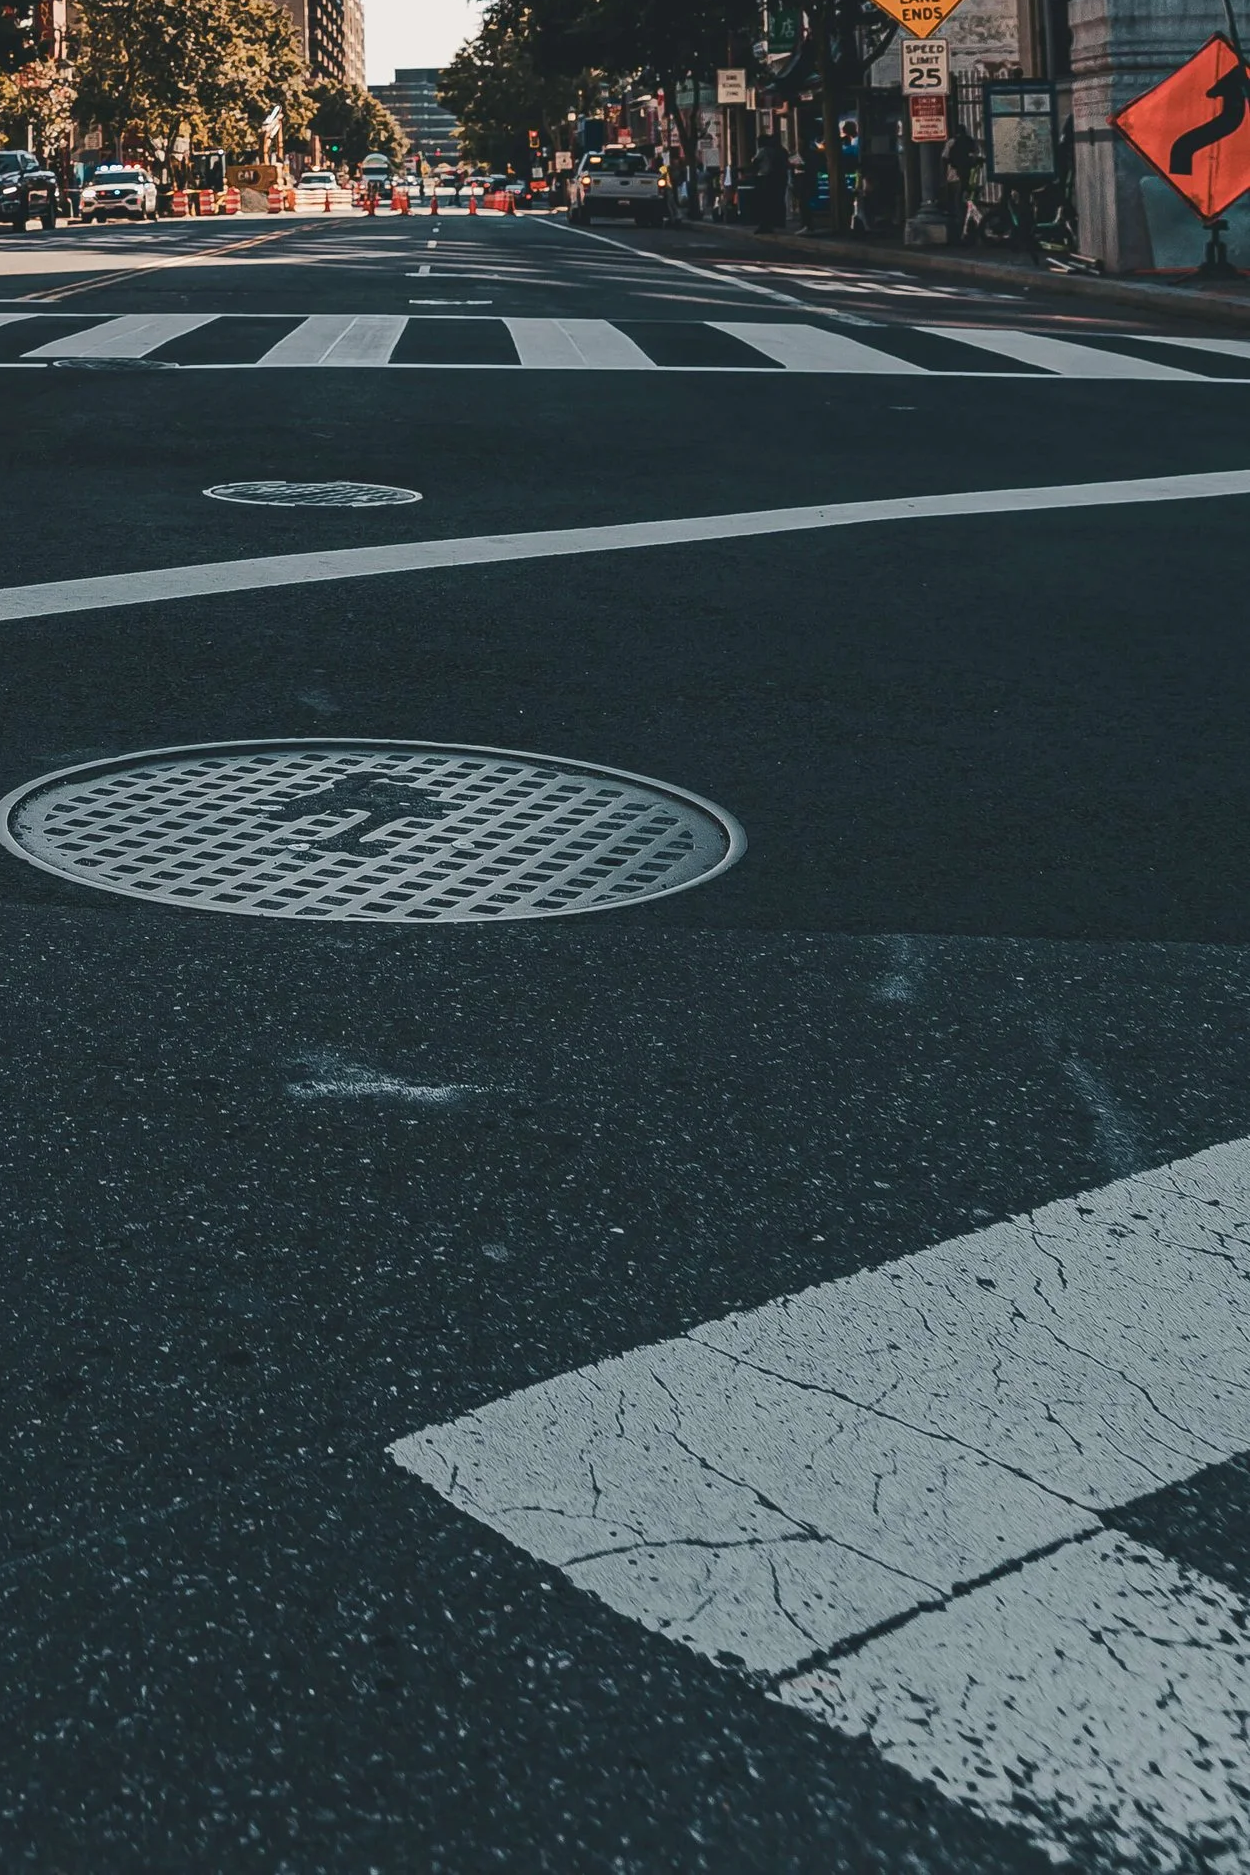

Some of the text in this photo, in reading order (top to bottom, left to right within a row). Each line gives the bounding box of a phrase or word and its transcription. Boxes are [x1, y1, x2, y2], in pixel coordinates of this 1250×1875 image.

[902, 6, 944, 22] ENDS
[905, 44, 945, 55] SPEED
[909, 56, 940, 66] LIMIT
[908, 68, 943, 88] 25
[237, 170, 254, 181] CAT
